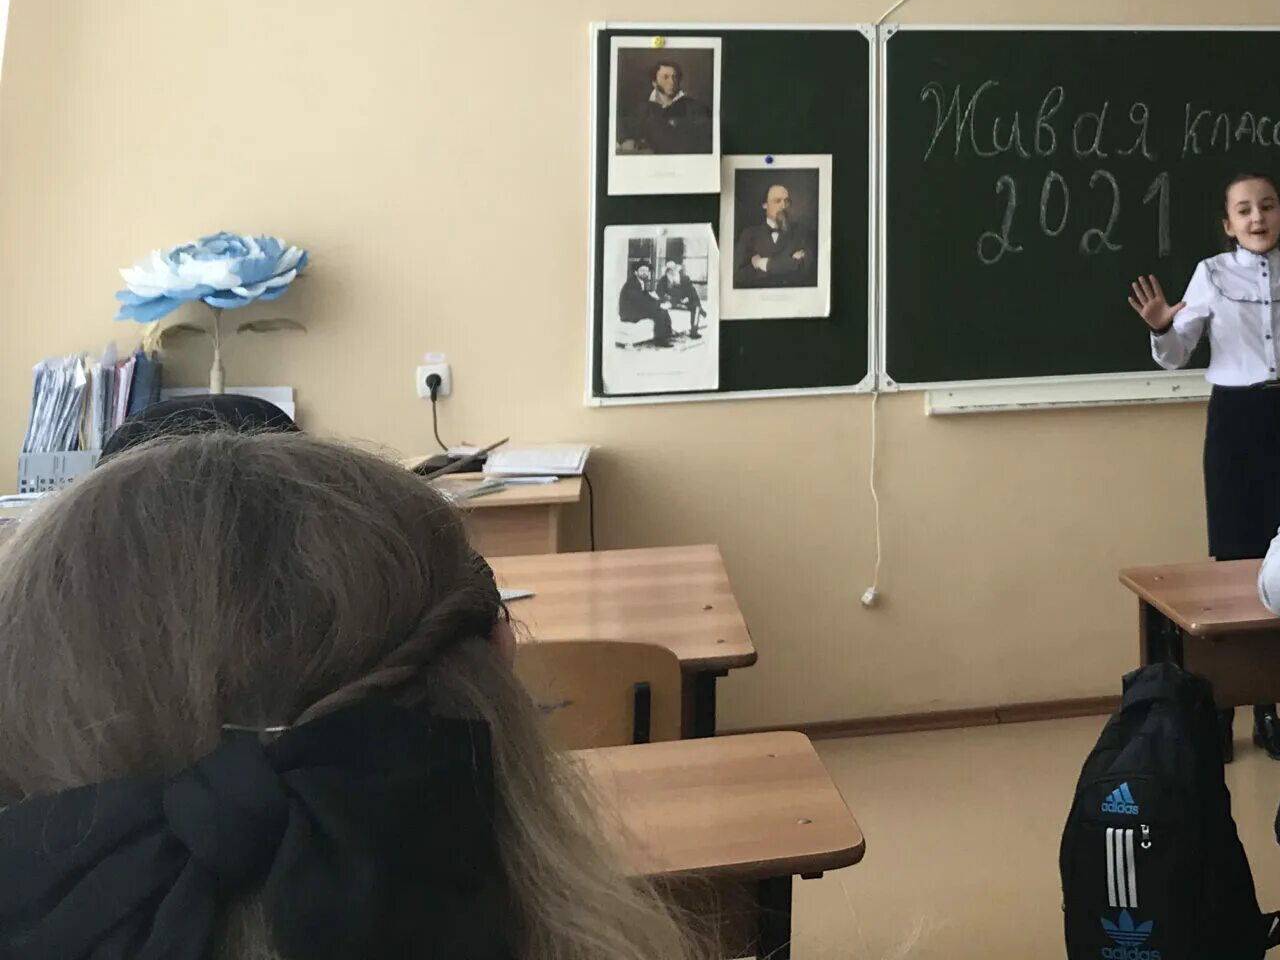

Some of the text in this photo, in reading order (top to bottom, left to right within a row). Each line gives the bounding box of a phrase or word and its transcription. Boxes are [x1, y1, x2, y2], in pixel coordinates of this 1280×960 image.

[920, 80, 1155, 161] Живая
[976, 170, 1171, 265] 2021
[1101, 801, 1139, 816] adidas
[1102, 942, 1162, 960] adidas
